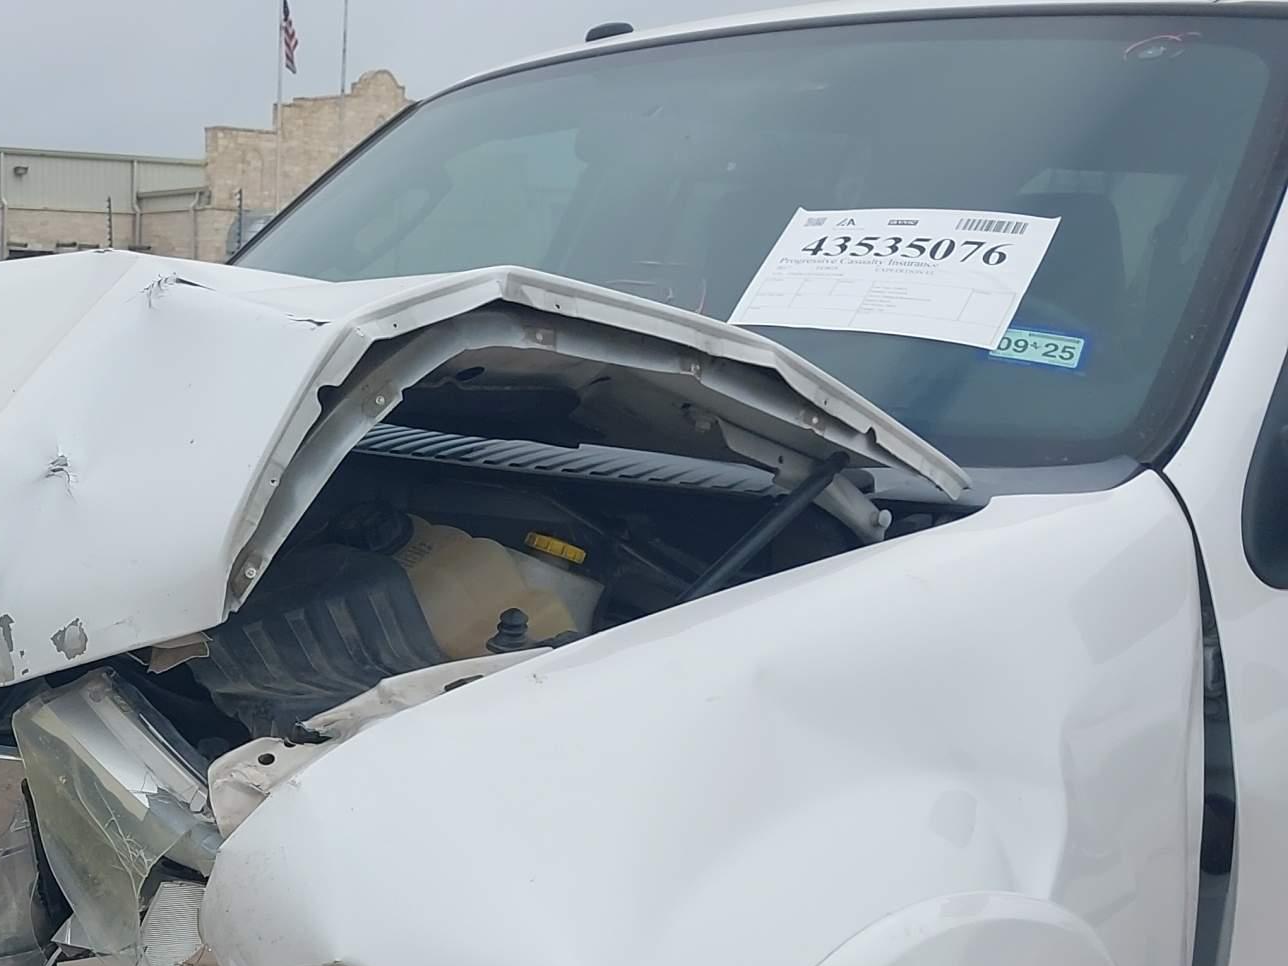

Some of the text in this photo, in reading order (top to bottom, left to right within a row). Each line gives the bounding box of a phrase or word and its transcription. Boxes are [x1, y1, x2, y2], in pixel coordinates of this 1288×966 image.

[779, 256, 837, 267] Progressive
[887, 258, 938, 269] Insurance
[801, 235, 1015, 265] 43535076
[997, 336, 1029, 353] 09
[1041, 343, 1076, 361] 25
